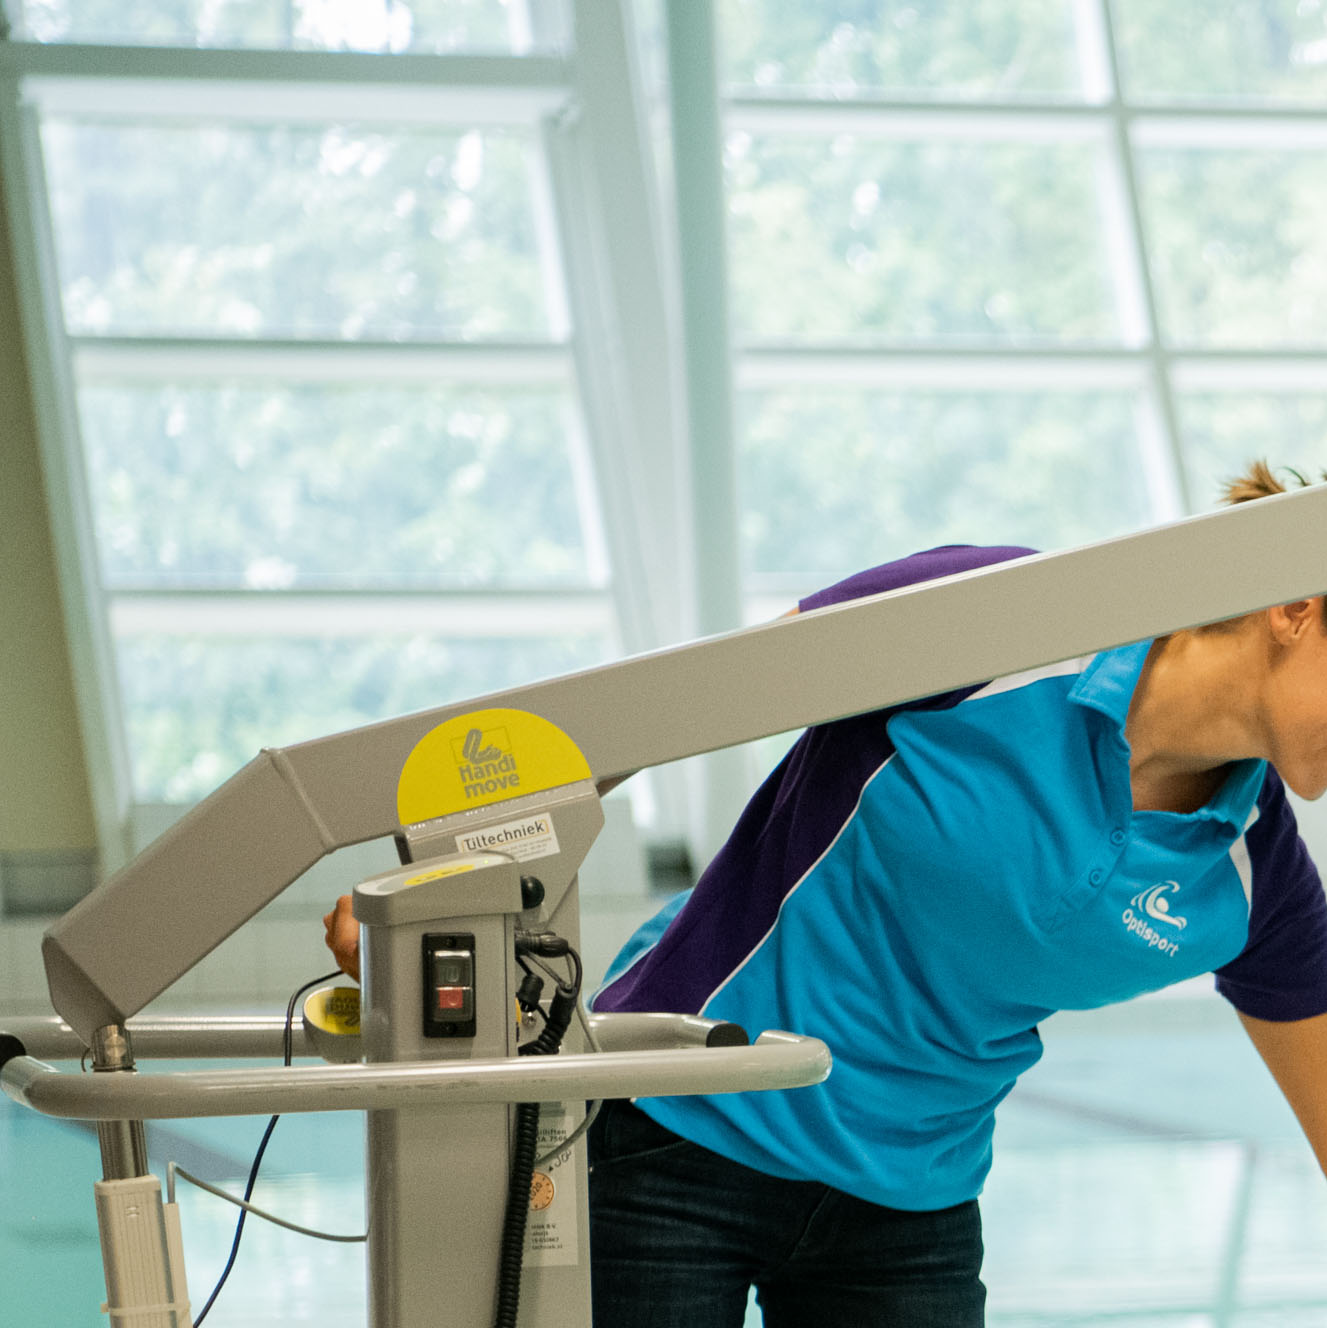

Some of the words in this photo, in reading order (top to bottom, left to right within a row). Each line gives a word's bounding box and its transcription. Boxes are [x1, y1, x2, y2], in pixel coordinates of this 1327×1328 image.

[458, 753, 517, 783] Handi
[464, 774, 520, 799] move
[464, 821, 545, 851] Tiltechniek
[1122, 908, 1179, 957] Optisport
